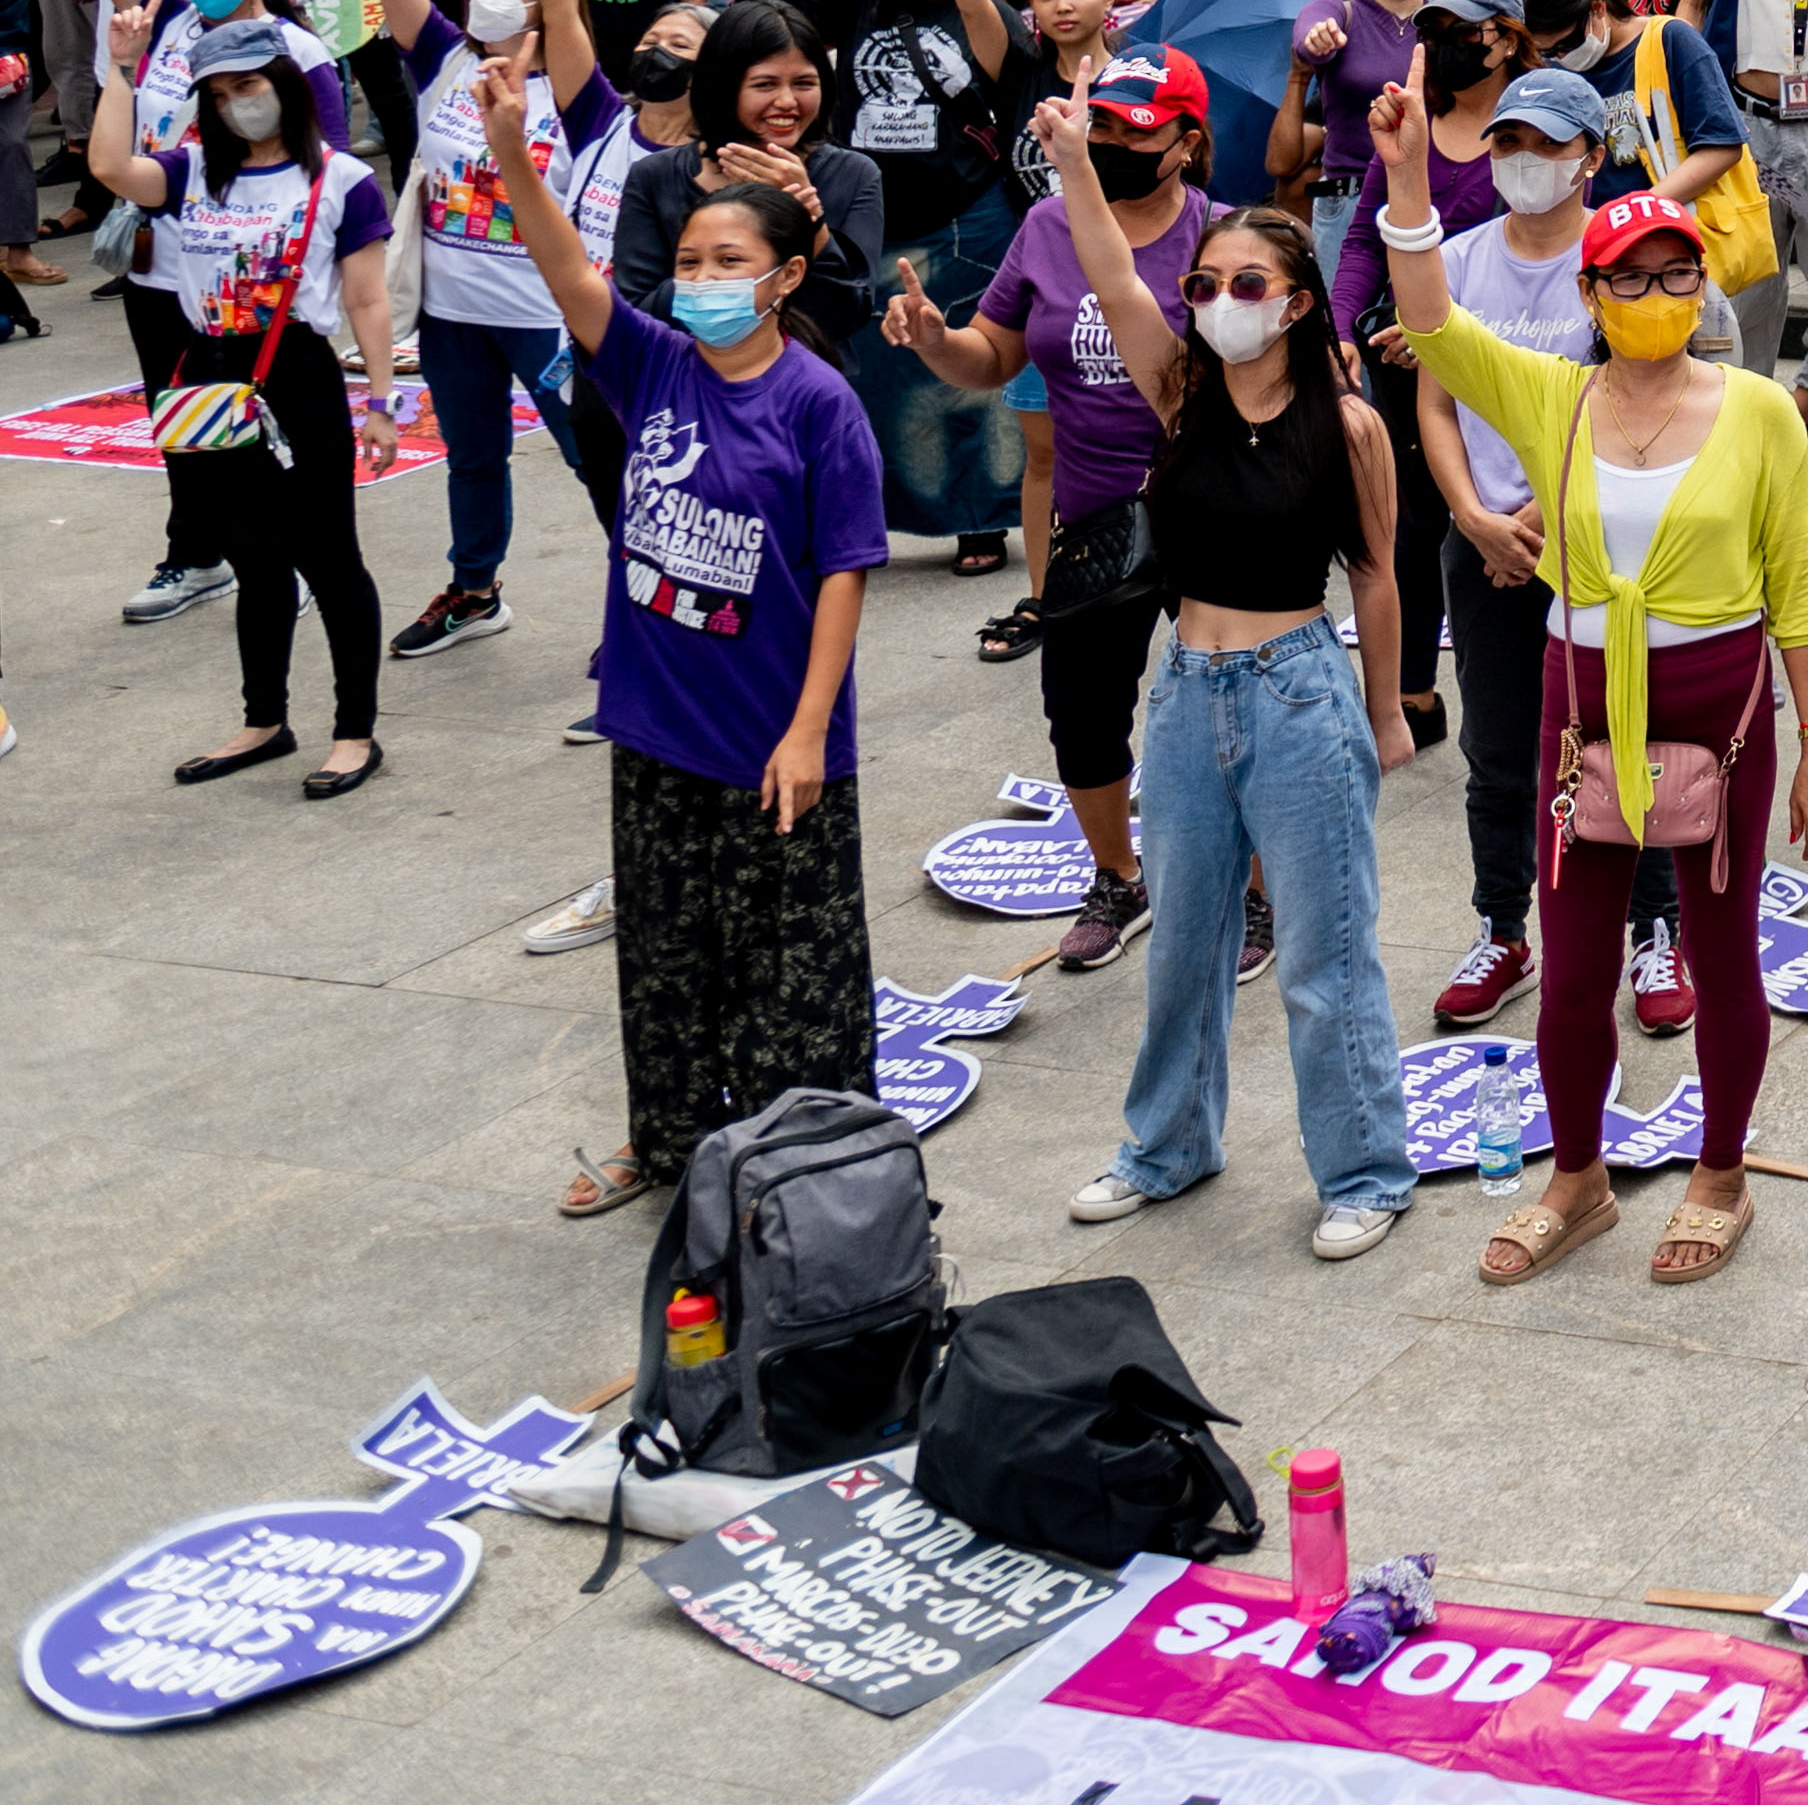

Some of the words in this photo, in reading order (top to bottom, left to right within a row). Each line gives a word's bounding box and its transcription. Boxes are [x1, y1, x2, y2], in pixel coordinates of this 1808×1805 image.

[1608, 195, 1681, 230] BTS
[656, 487, 765, 552] SULONG
[124, 1552, 346, 1612] CHARTER
[208, 1525, 447, 1581] CHANGE!
[857, 1487, 937, 1545] NO
[917, 1517, 976, 1563] TO
[949, 1543, 1115, 1626] JEEPNEY
[819, 1536, 1029, 1644] PHASE-OUT
[99, 1595, 316, 1655] SAHOD
